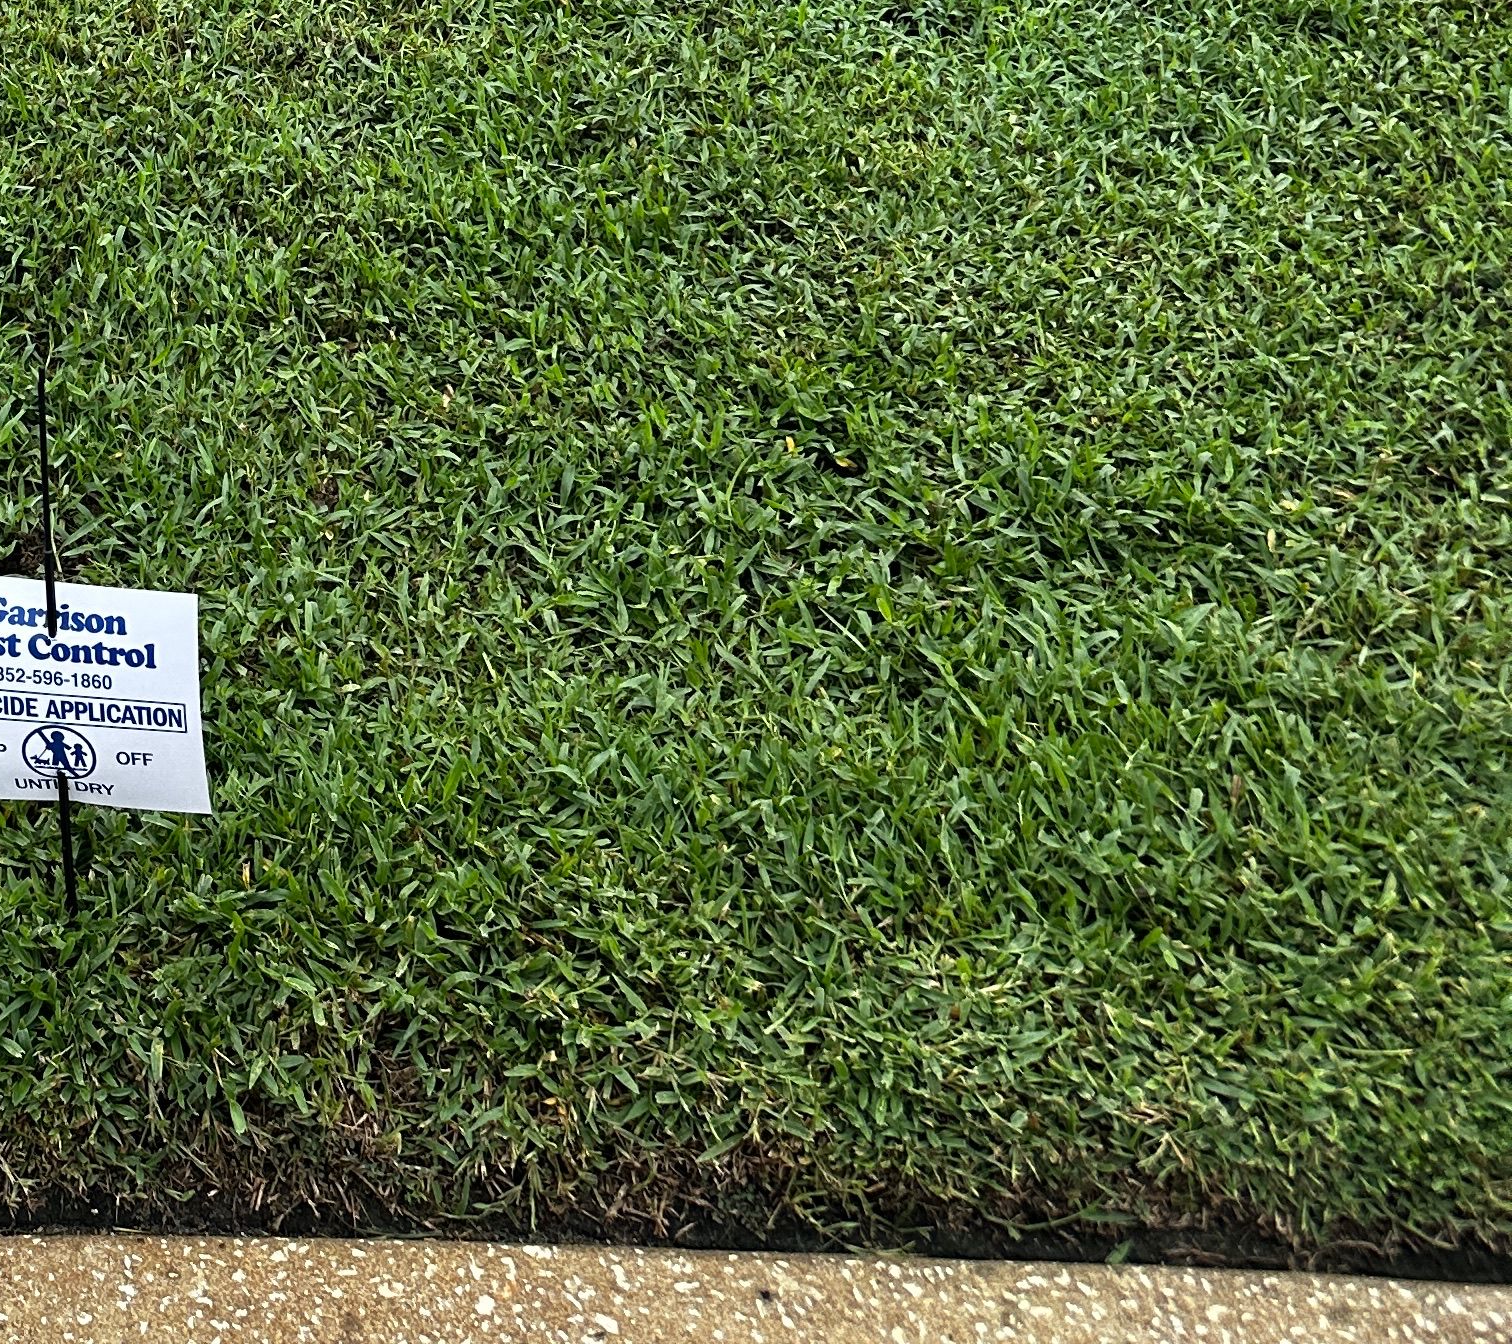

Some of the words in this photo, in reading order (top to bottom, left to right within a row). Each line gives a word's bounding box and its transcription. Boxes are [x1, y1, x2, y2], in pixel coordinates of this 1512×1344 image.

[28, 634, 157, 669] Control
[45, 700, 183, 728] APPLICATION
[116, 752, 153, 766] OFF
[15, 778, 70, 790] UNTI
[75, 781, 114, 796] DRY
